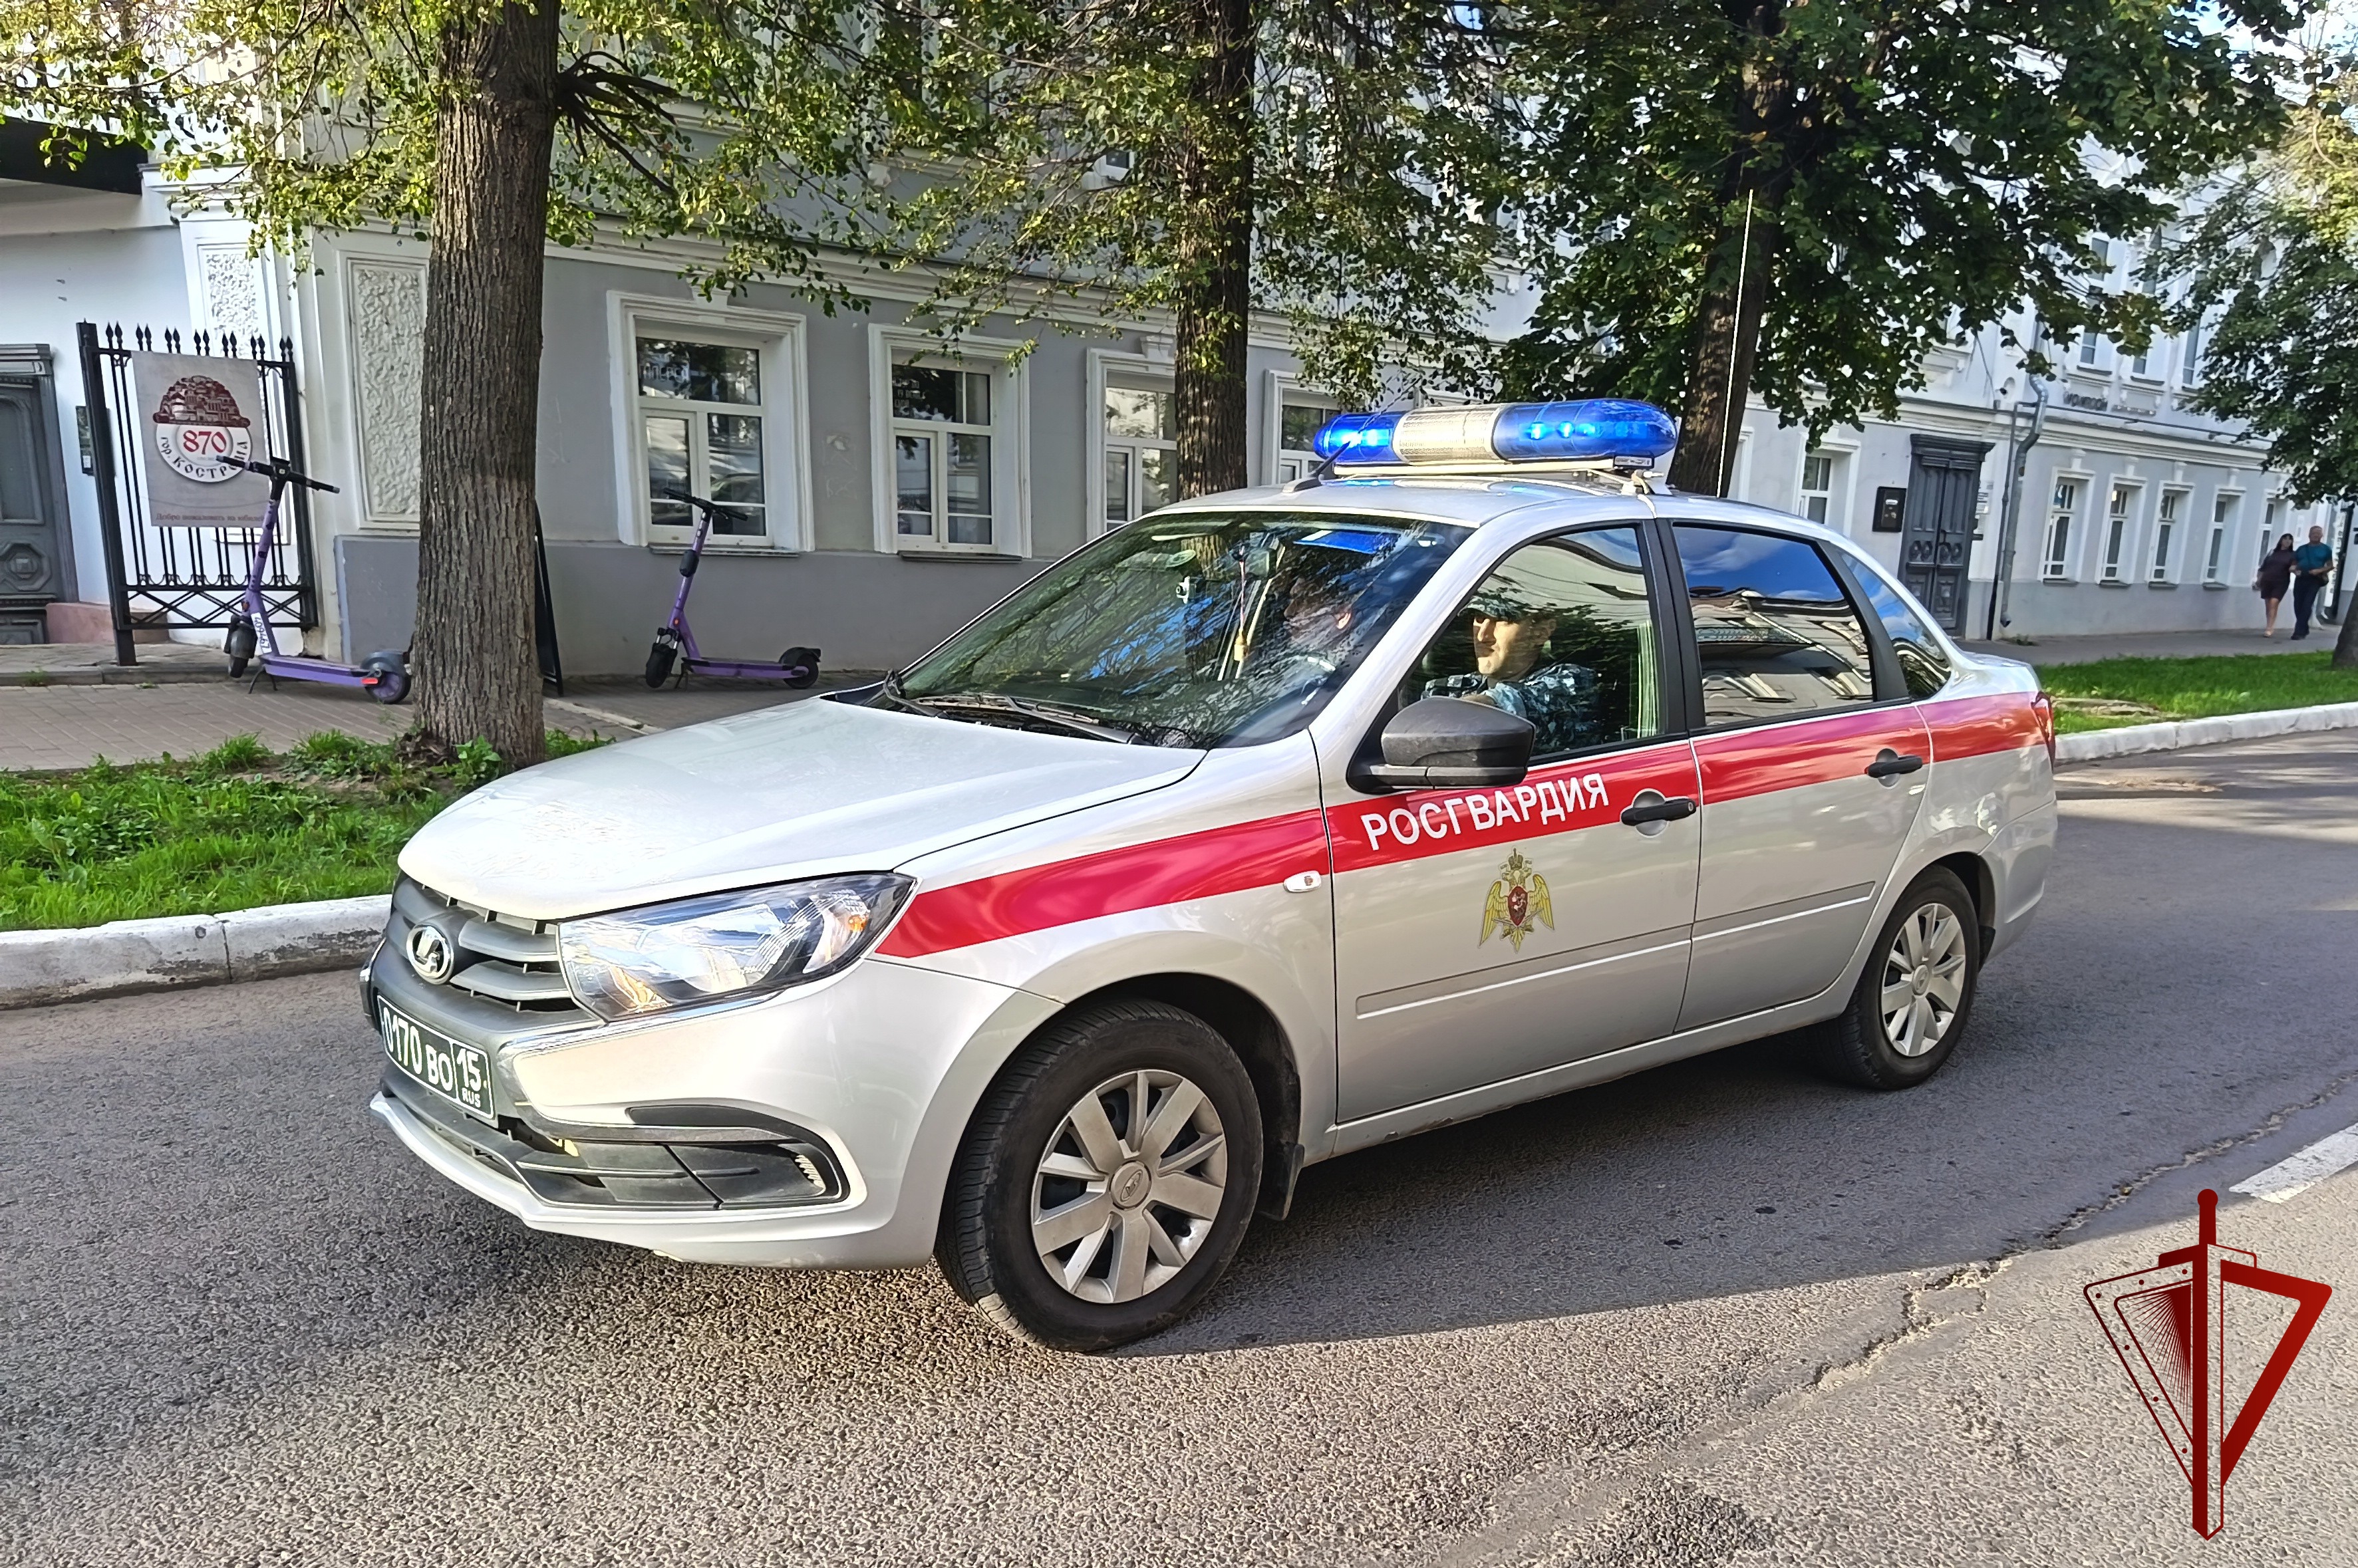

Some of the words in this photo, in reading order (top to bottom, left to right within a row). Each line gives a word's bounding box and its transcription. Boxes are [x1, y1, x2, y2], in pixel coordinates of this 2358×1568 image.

[160, 436, 172, 459] гор.
[172, 441, 248, 479] КОСТРМА
[183, 430, 227, 455] 870
[1360, 773, 1610, 851] РОСГВАРДИЯ
[383, 1007, 422, 1075] 0170
[425, 1044, 454, 1091] ВО
[456, 1048, 482, 1091] 15
[462, 1087, 481, 1108] RUS
